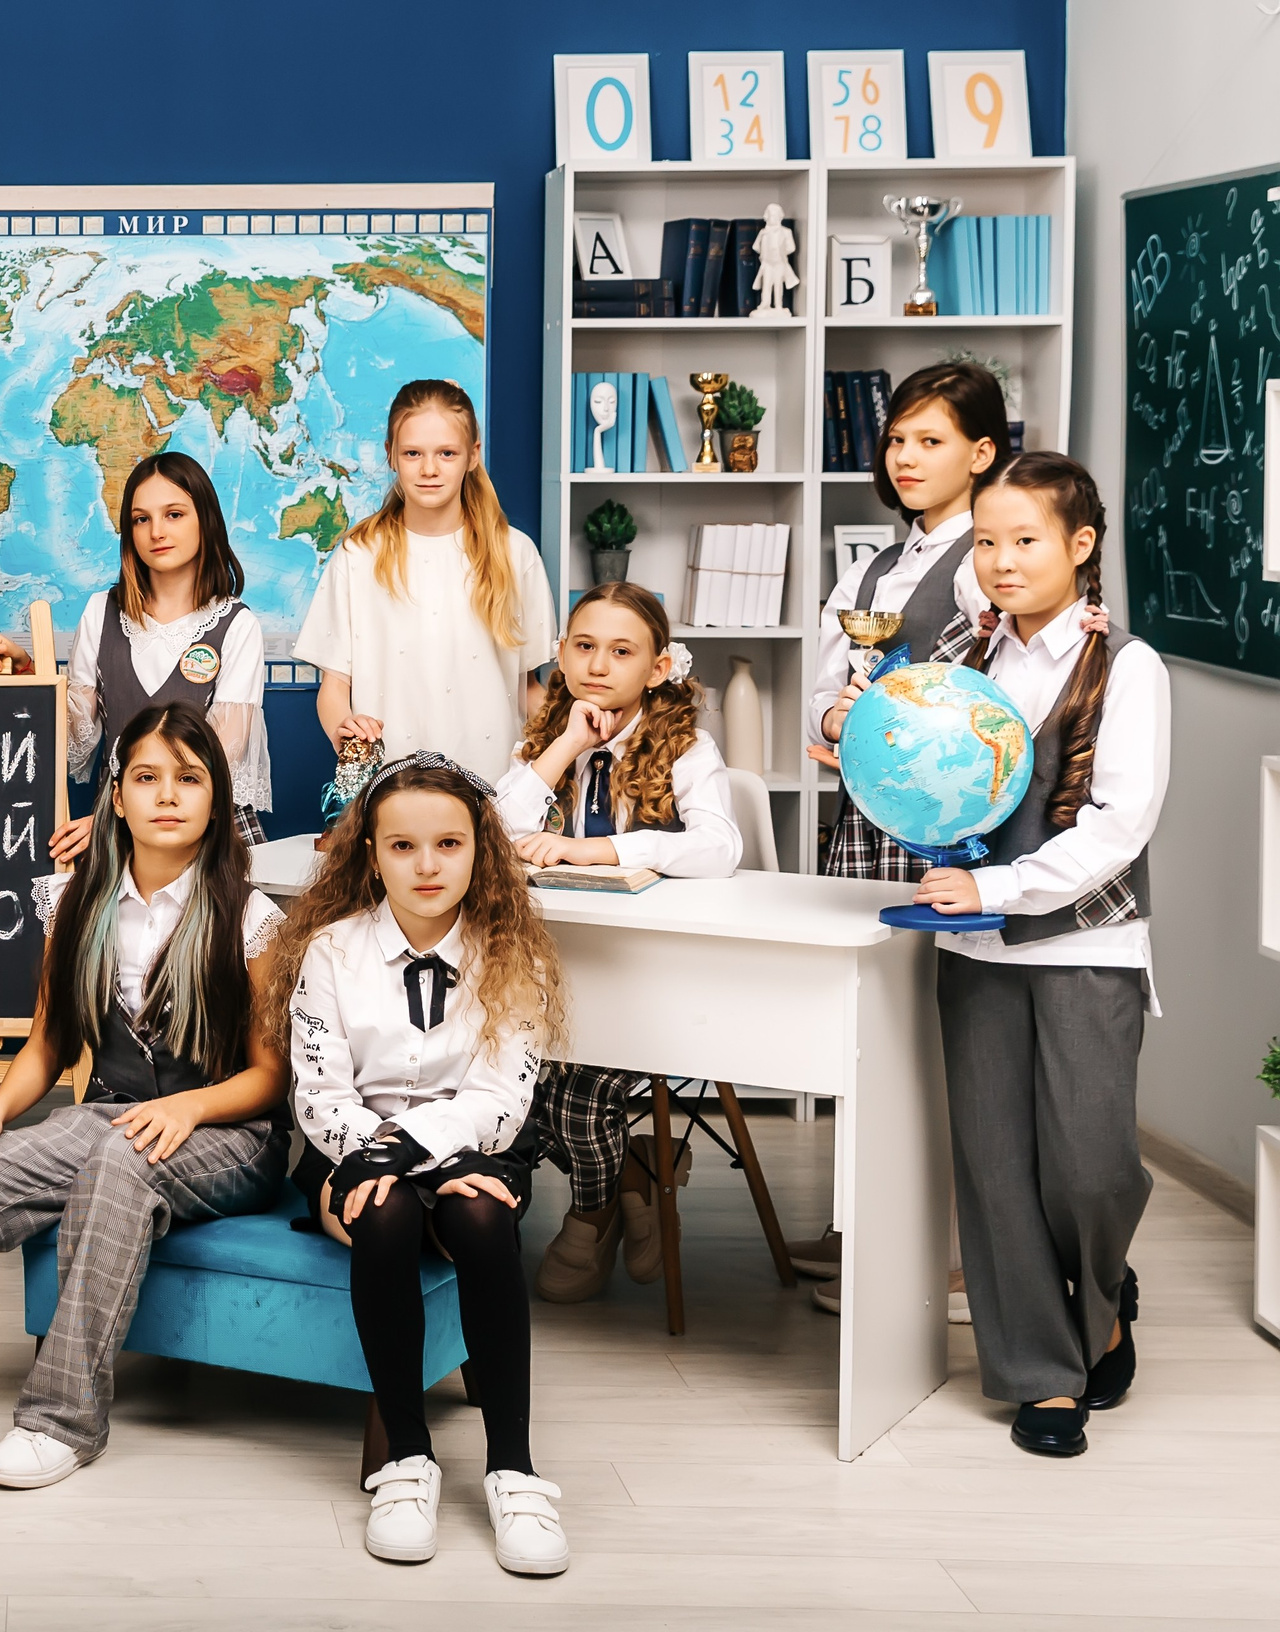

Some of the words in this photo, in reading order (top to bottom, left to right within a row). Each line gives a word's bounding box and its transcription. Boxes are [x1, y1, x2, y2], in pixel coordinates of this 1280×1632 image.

[965, 72, 1003, 148] 9
[118, 215, 189, 234] МИР
[590, 231, 623, 274] А
[841, 257, 875, 306] Б
